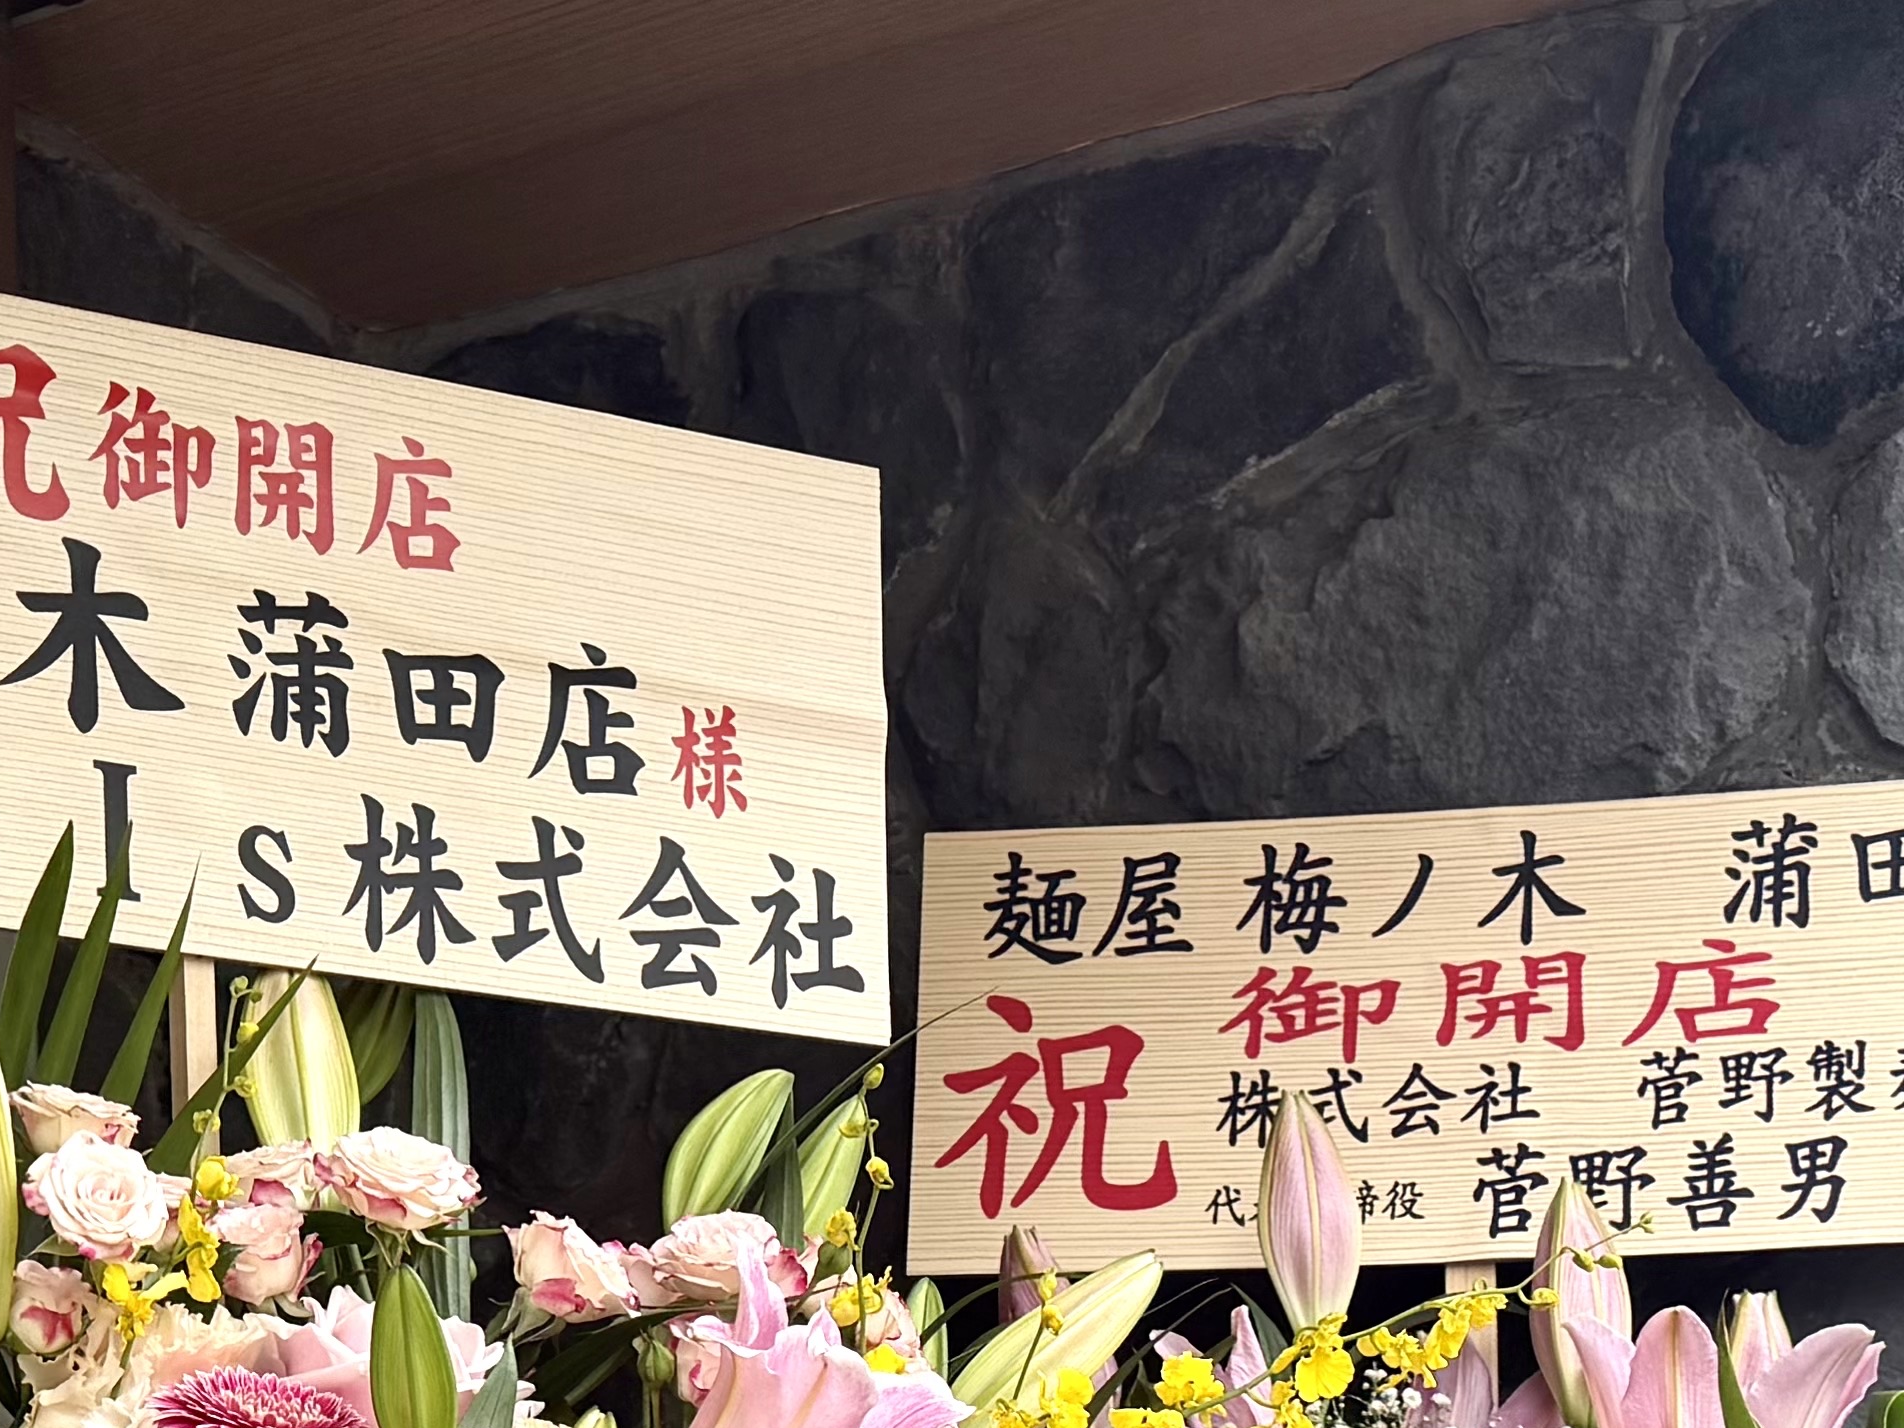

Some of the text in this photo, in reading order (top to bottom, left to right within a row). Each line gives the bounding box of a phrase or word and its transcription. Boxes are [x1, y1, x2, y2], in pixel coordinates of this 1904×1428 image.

[981, 850, 1194, 966] 麺屋
[1235, 830, 1588, 955] 梅ノ木
[1218, 938, 1782, 1064] 御開店
[936, 995, 1179, 1219] 祝
[1215, 1060, 1542, 1150] 株式会社
[1471, 1131, 1850, 1240] 菅野善男
